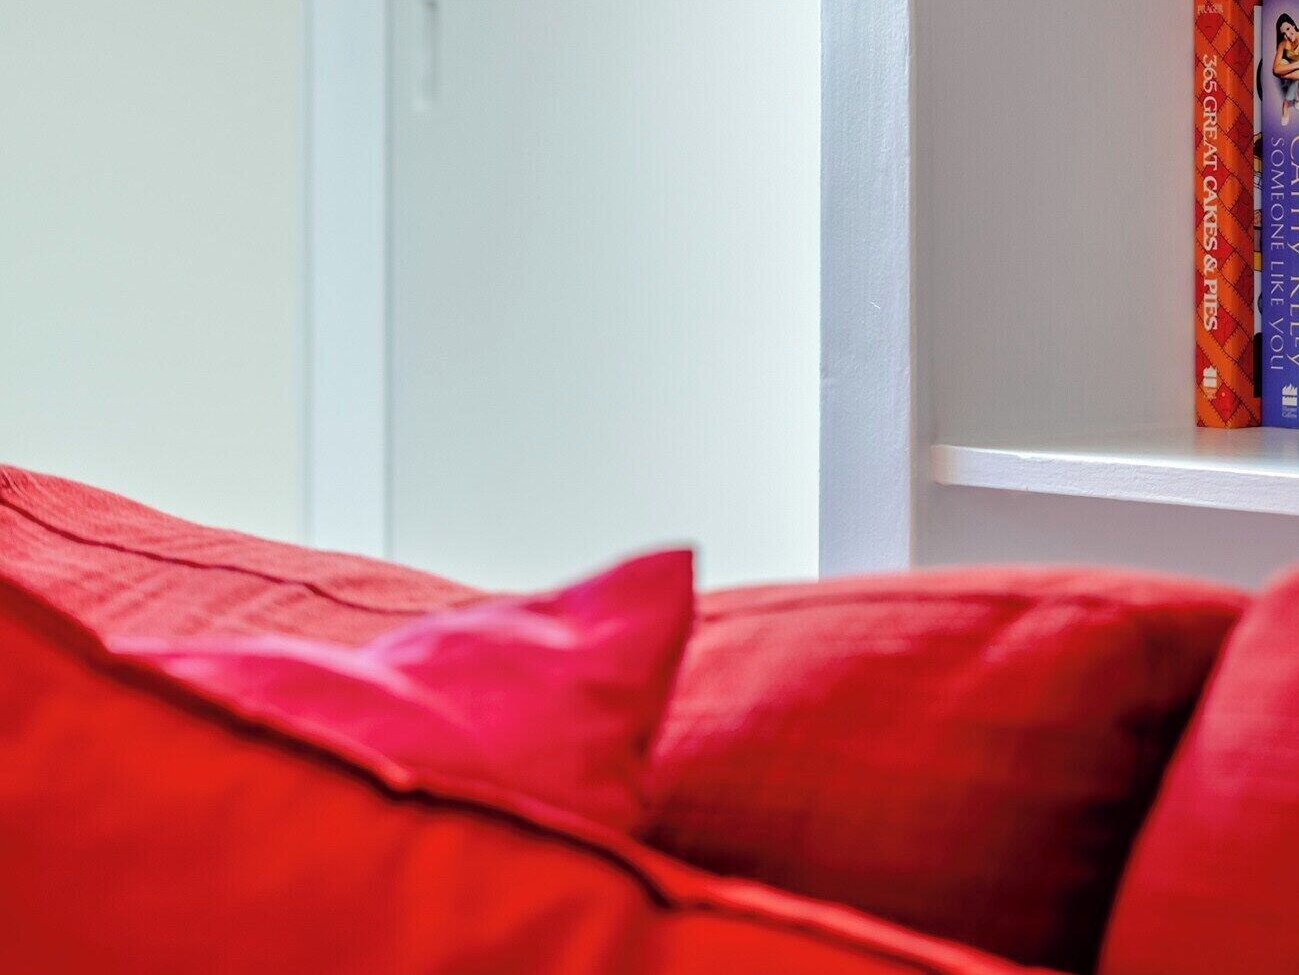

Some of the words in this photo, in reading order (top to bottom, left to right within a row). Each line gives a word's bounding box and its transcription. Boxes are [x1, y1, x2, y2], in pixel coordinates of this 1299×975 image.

[1203, 55, 1217, 92] 365
[1203, 97, 1217, 170] GREAT
[1203, 176, 1217, 251] CAKES
[1270, 137, 1284, 250] SOMEONE
[1203, 255, 1217, 274] &
[1270, 261, 1284, 306] LIKE
[1203, 279, 1217, 331] PIES
[1269, 318, 1284, 370] YOU
